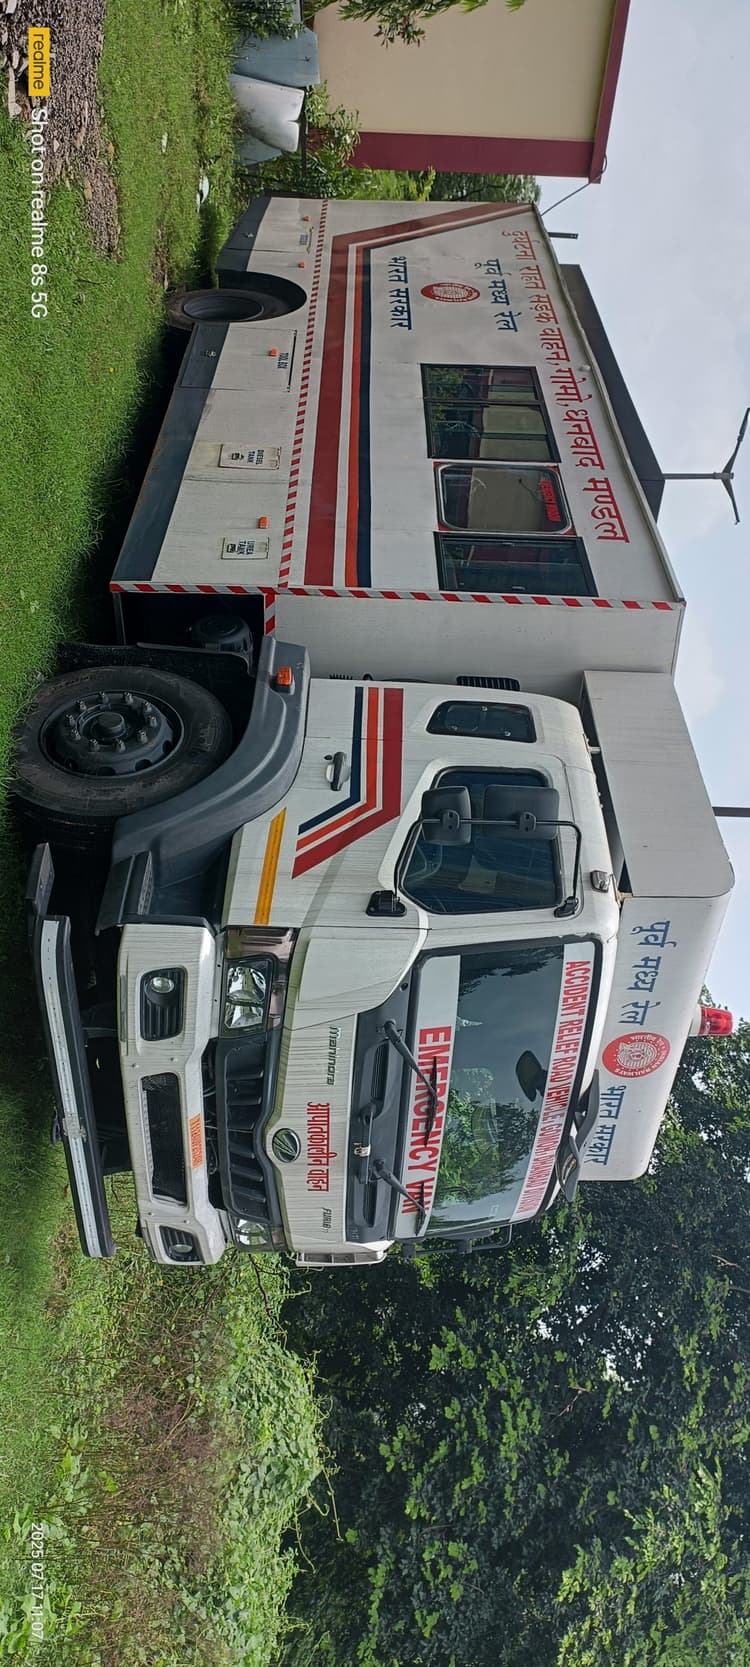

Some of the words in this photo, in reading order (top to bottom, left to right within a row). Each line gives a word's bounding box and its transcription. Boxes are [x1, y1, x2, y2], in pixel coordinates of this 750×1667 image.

[388, 256, 408, 284] भारत
[474, 258, 511, 276] पूर्व
[520, 265, 546, 290] राहत
[488, 279, 510, 306] मध्य
[388, 288, 412, 330] सरकार
[494, 311, 522, 332] रेल
[528, 294, 558, 324] सड़क
[562, 410, 604, 470] धनबाद
[246, 450, 256, 464] TANK
[256, 450, 264, 465] DIESEL
[582, 478, 630, 543] मण्डल
[238, 540, 246, 556] TANK
[246, 540, 255, 555] UREA
[630, 920, 677, 948] पूर्व
[626, 956, 662, 992] मध्य
[560, 960, 591, 1017] ACCIDENT
[618, 1000, 661, 1026] रेल
[555, 1019, 584, 1056] RELIEF
[550, 1056, 576, 1083] ROAD
[407, 1026, 452, 1172] EMERGENCY
[600, 1086, 626, 1120] भारत
[306, 1102, 338, 1166] आपातकालीन
[584, 1124, 616, 1166] सरकार
[306, 1168, 330, 1192] वाहन
[401, 1176, 436, 1215] VAN
